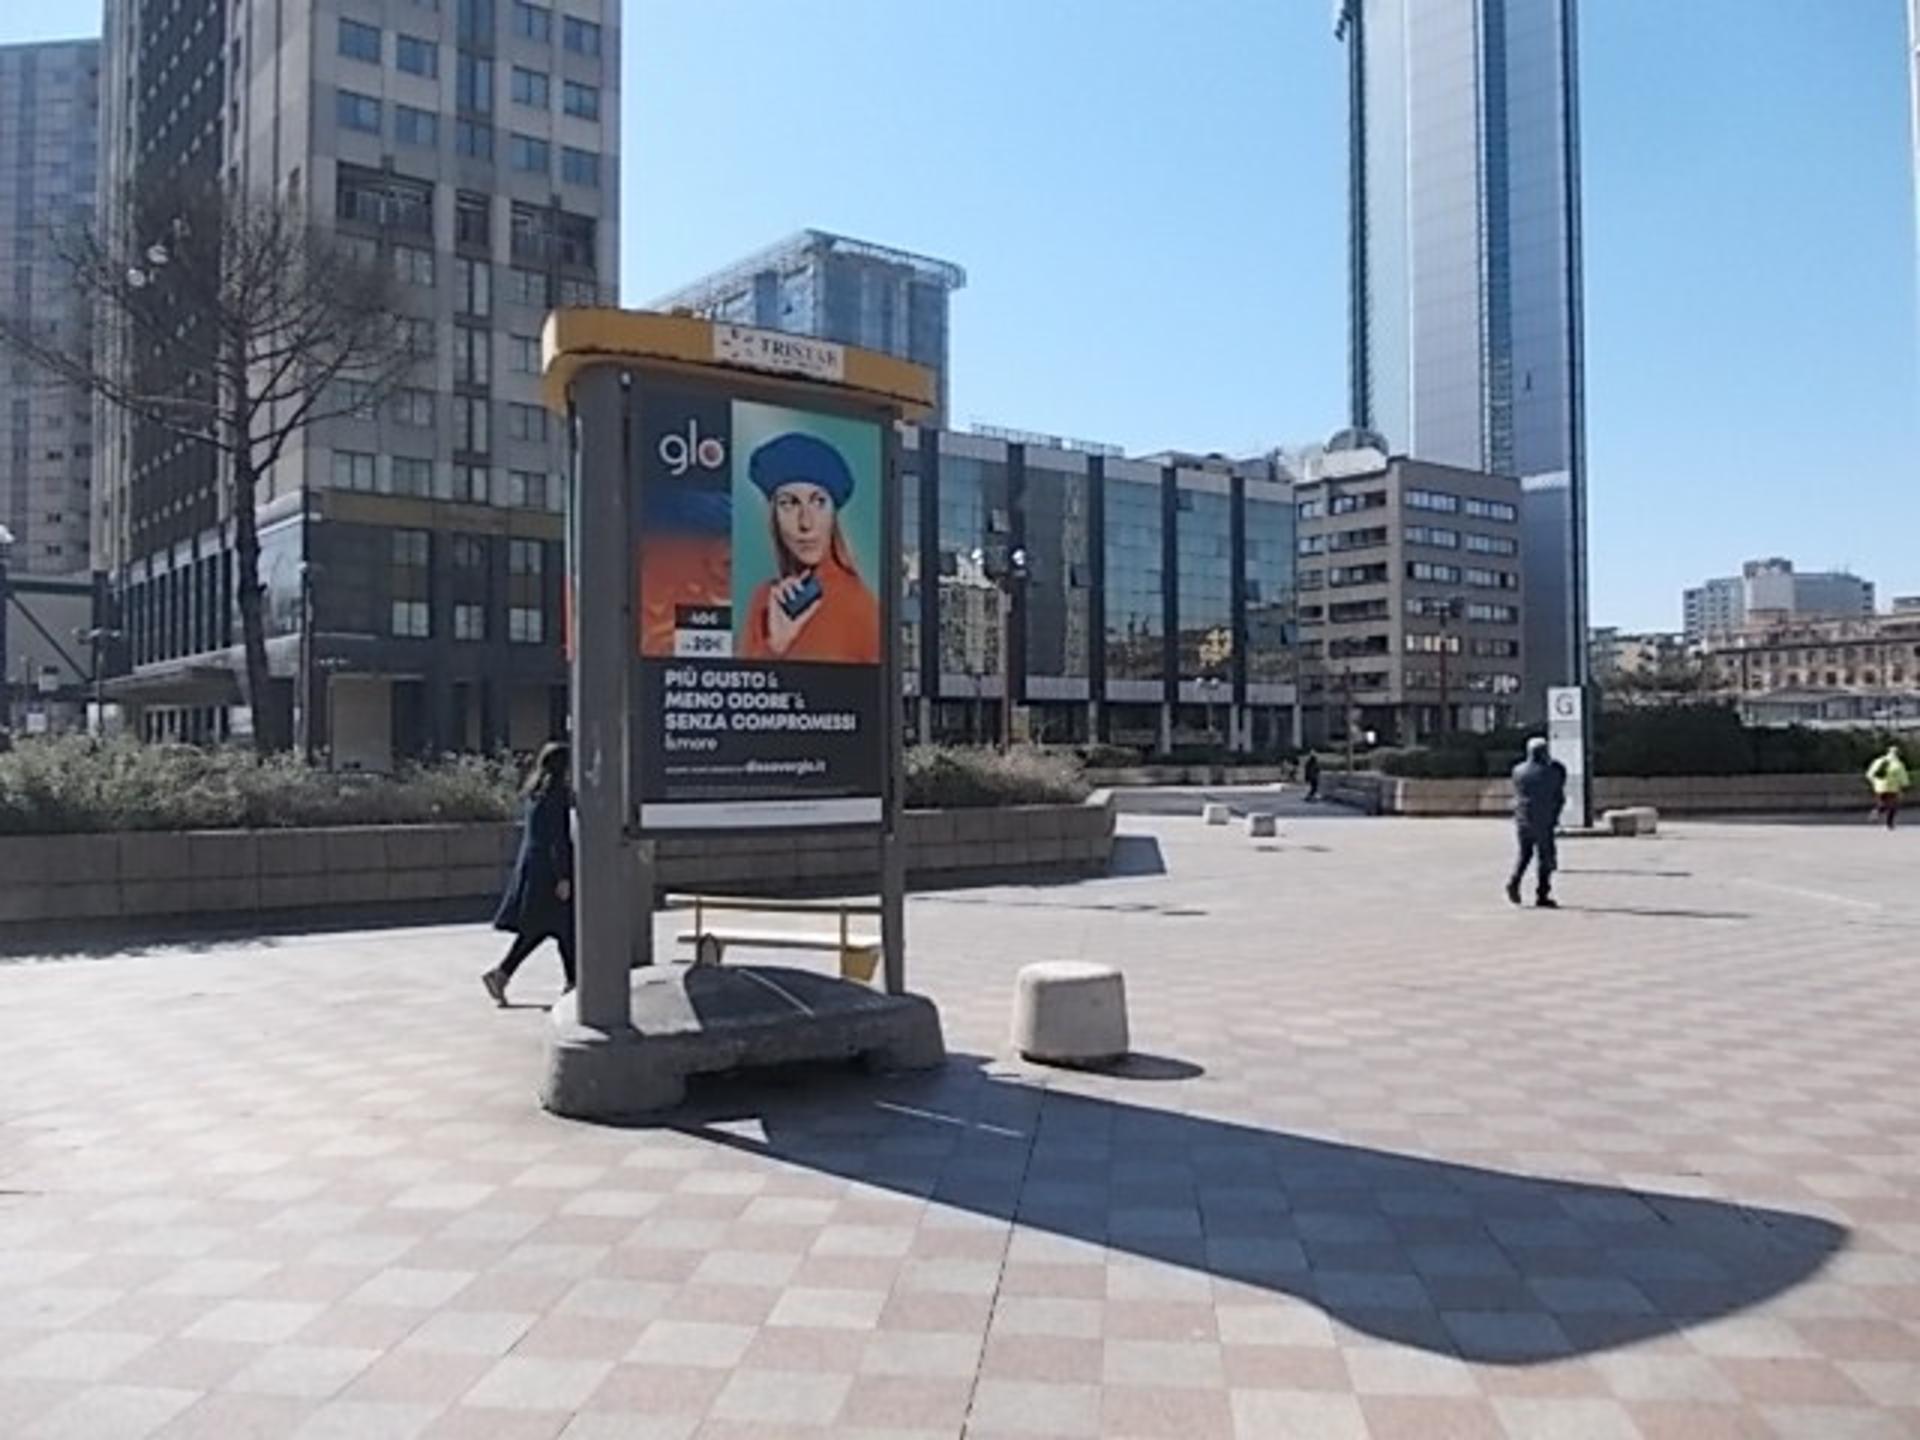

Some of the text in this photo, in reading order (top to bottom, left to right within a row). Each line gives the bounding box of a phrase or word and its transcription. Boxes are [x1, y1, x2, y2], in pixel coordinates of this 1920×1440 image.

[659, 419, 724, 475] glo
[665, 666, 698, 688] PIÙ
[702, 671, 766, 688] GUSTO
[665, 692, 724, 709] MENO
[1556, 693, 1574, 716] G
[665, 713, 856, 730] SENZA COMPROMESSI
